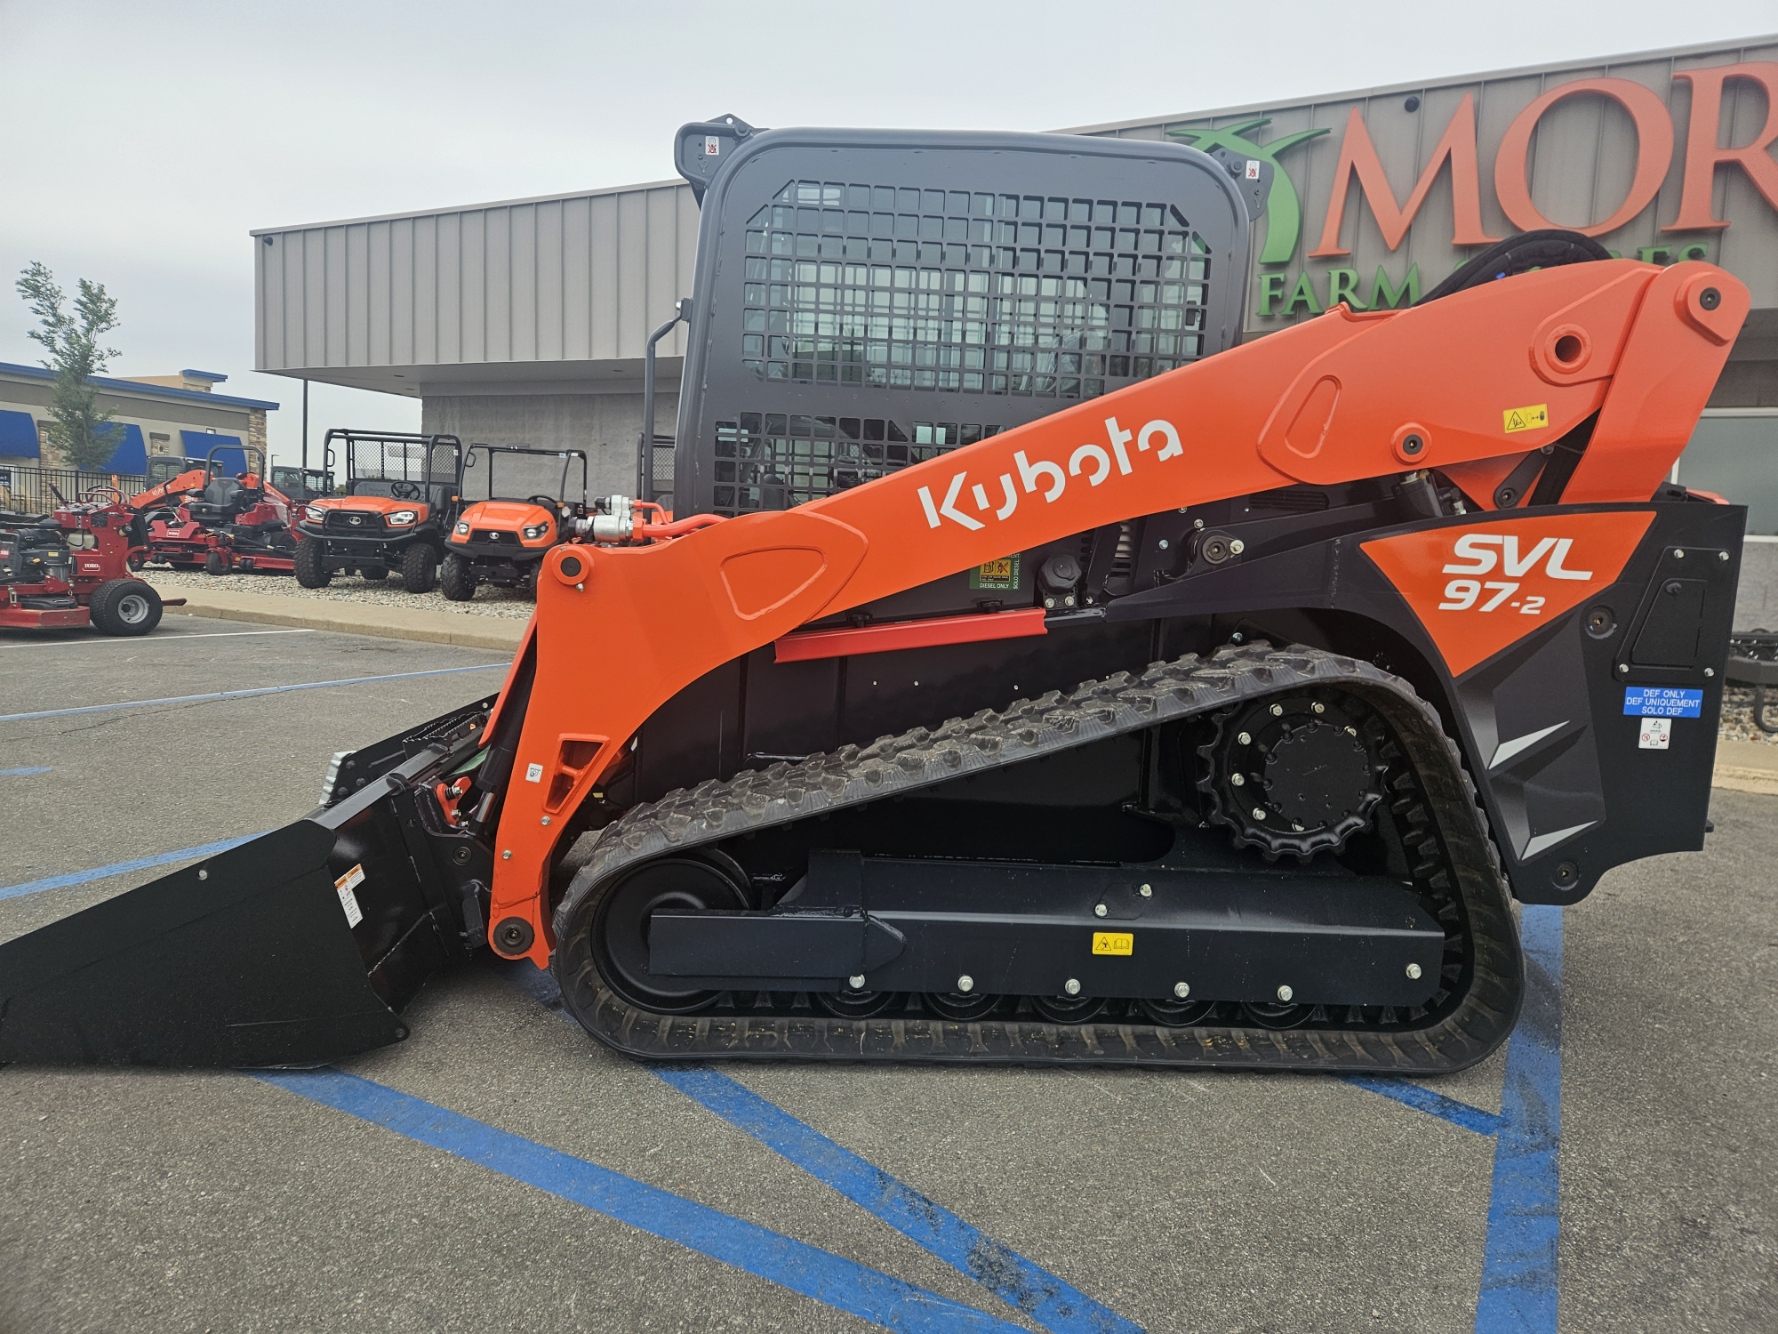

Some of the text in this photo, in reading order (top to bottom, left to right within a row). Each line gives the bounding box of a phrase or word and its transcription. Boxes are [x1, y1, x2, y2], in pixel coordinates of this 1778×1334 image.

[1308, 61, 1778, 258] MOR
[1255, 262, 1422, 317] FARM
[917, 416, 1184, 531] Kubota
[1442, 533, 1594, 581] SVL
[1438, 579, 1546, 615] 97-2
[1626, 697, 1700, 708] DEF UNIQUEMENT
[1641, 706, 1683, 715] SOLO DEF
[1643, 689, 1686, 698] DEF ONLY
